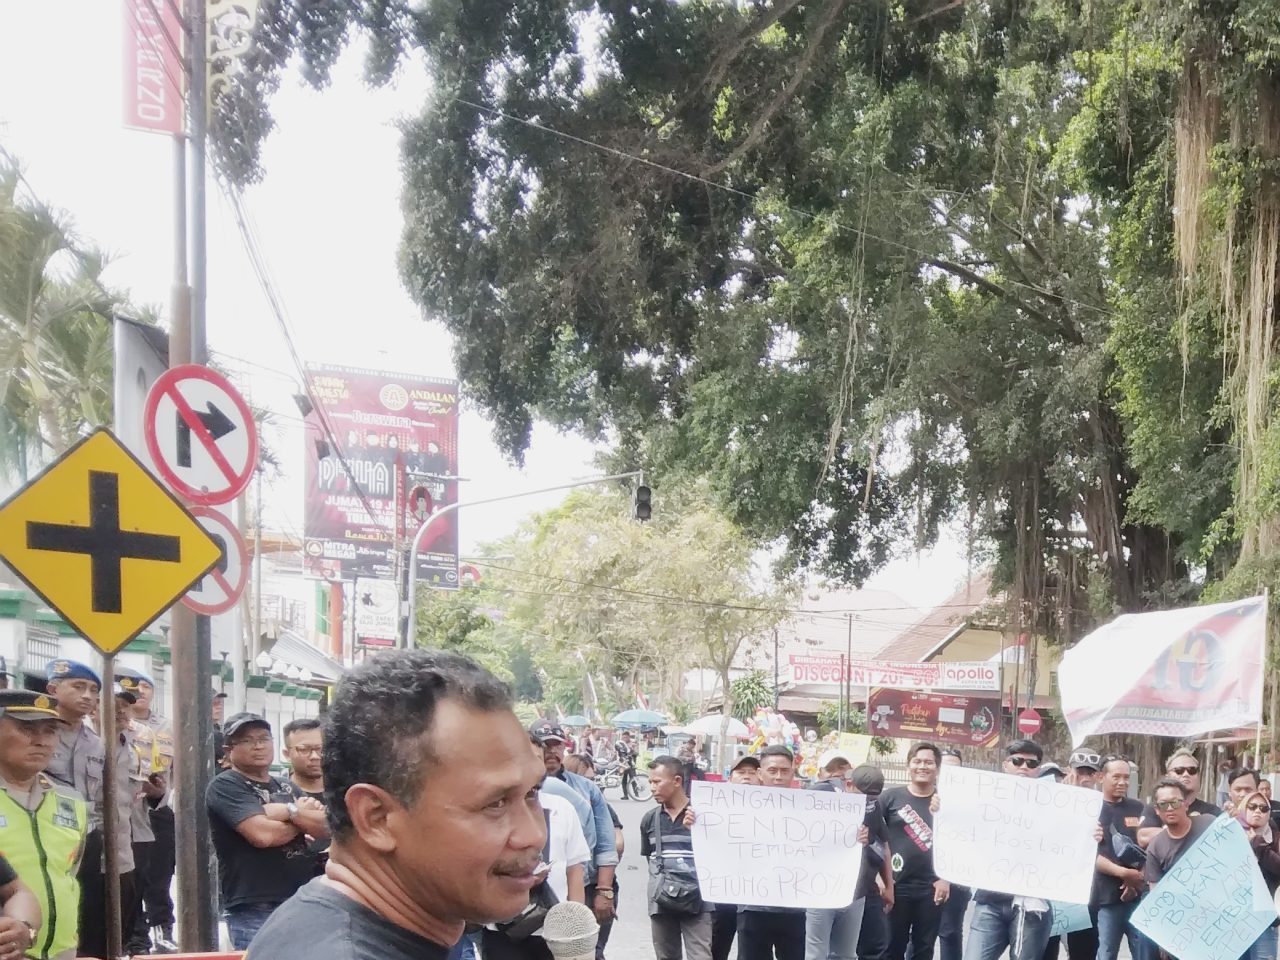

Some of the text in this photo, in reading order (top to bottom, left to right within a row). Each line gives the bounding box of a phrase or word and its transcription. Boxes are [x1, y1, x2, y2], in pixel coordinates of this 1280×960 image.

[410, 390, 455, 404] ANDALAN
[946, 667, 995, 685] apollo
[698, 785, 862, 816] JANGAN Jadikan
[695, 811, 859, 848] PENDOPO
[727, 841, 823, 860] TEMPAT
[1160, 858, 1229, 926] BUKAN
